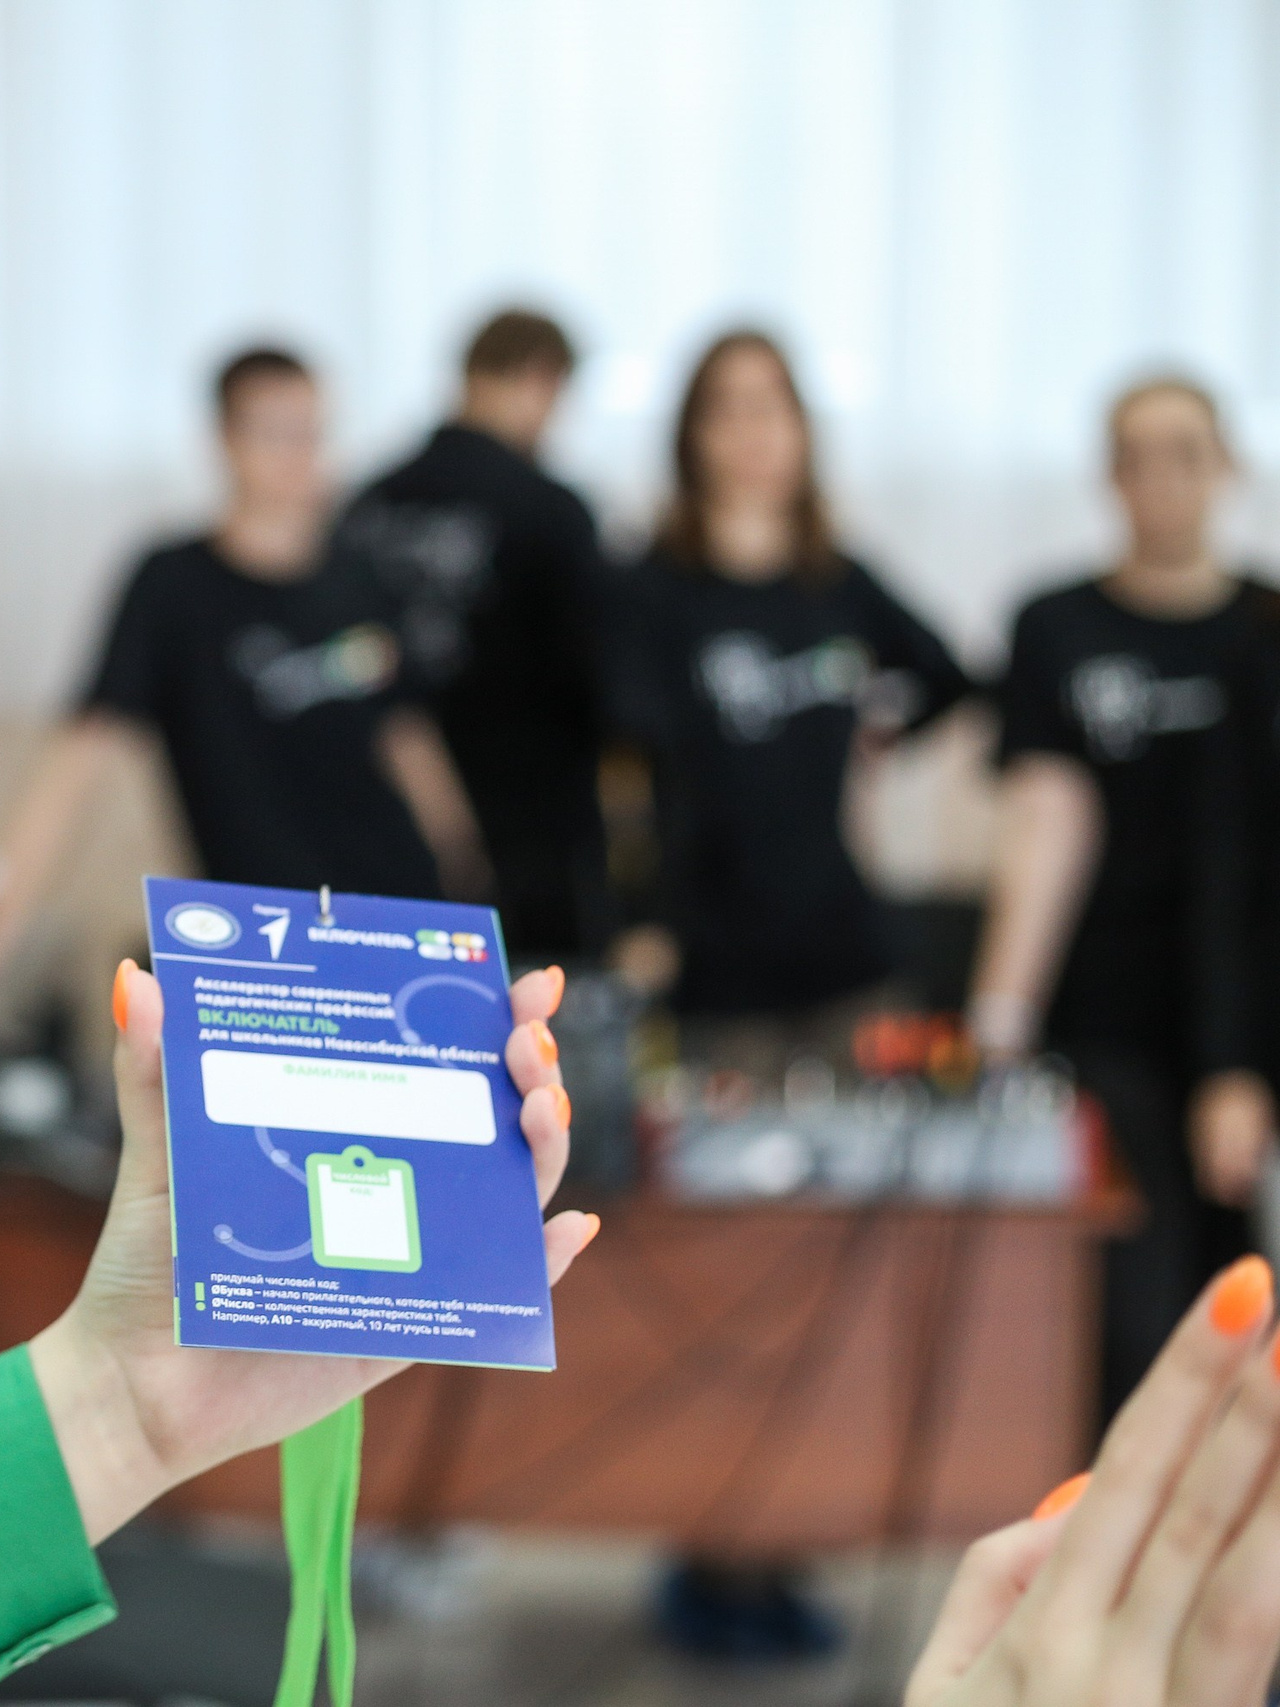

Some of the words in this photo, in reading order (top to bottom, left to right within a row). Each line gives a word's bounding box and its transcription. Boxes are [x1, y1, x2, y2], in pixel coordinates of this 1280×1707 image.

[194, 977, 290, 998] Акселератор
[291, 986, 391, 1005] современных
[195, 994, 313, 1013] педагогических
[314, 1003, 396, 1020] профессий
[198, 1009, 340, 1035] ВКЛЮЧАТЕЛЬ
[199, 1029, 230, 1041] для
[231, 1032, 323, 1049] школьников
[324, 1037, 439, 1058] Новосибирской
[439, 1046, 500, 1065] области
[283, 1064, 368, 1080] ФАМИЛИЯ
[371, 1072, 408, 1083] ИМЯ
[210, 1274, 264, 1285] придумай
[265, 1277, 316, 1288] числовой
[317, 1281, 340, 1290] код:
[262, 1289, 301, 1300] начало
[302, 1292, 394, 1307] прилагательного,
[395, 1299, 439, 1309] которое
[440, 1300, 465, 1311] тебя
[465, 1303, 543, 1317] характеризует.
[264, 1303, 350, 1316] количественная
[351, 1308, 433, 1321] характеристика
[434, 1312, 462, 1323] тебя.
[212, 1311, 270, 1325] Например,
[302, 1318, 368, 1331] аккуратный,
[369, 1321, 383, 1331] 10
[383, 1323, 402, 1332] лет
[402, 1325, 432, 1335] учусь
[432, 1326, 440, 1335] в
[441, 1328, 477, 1338] школе
